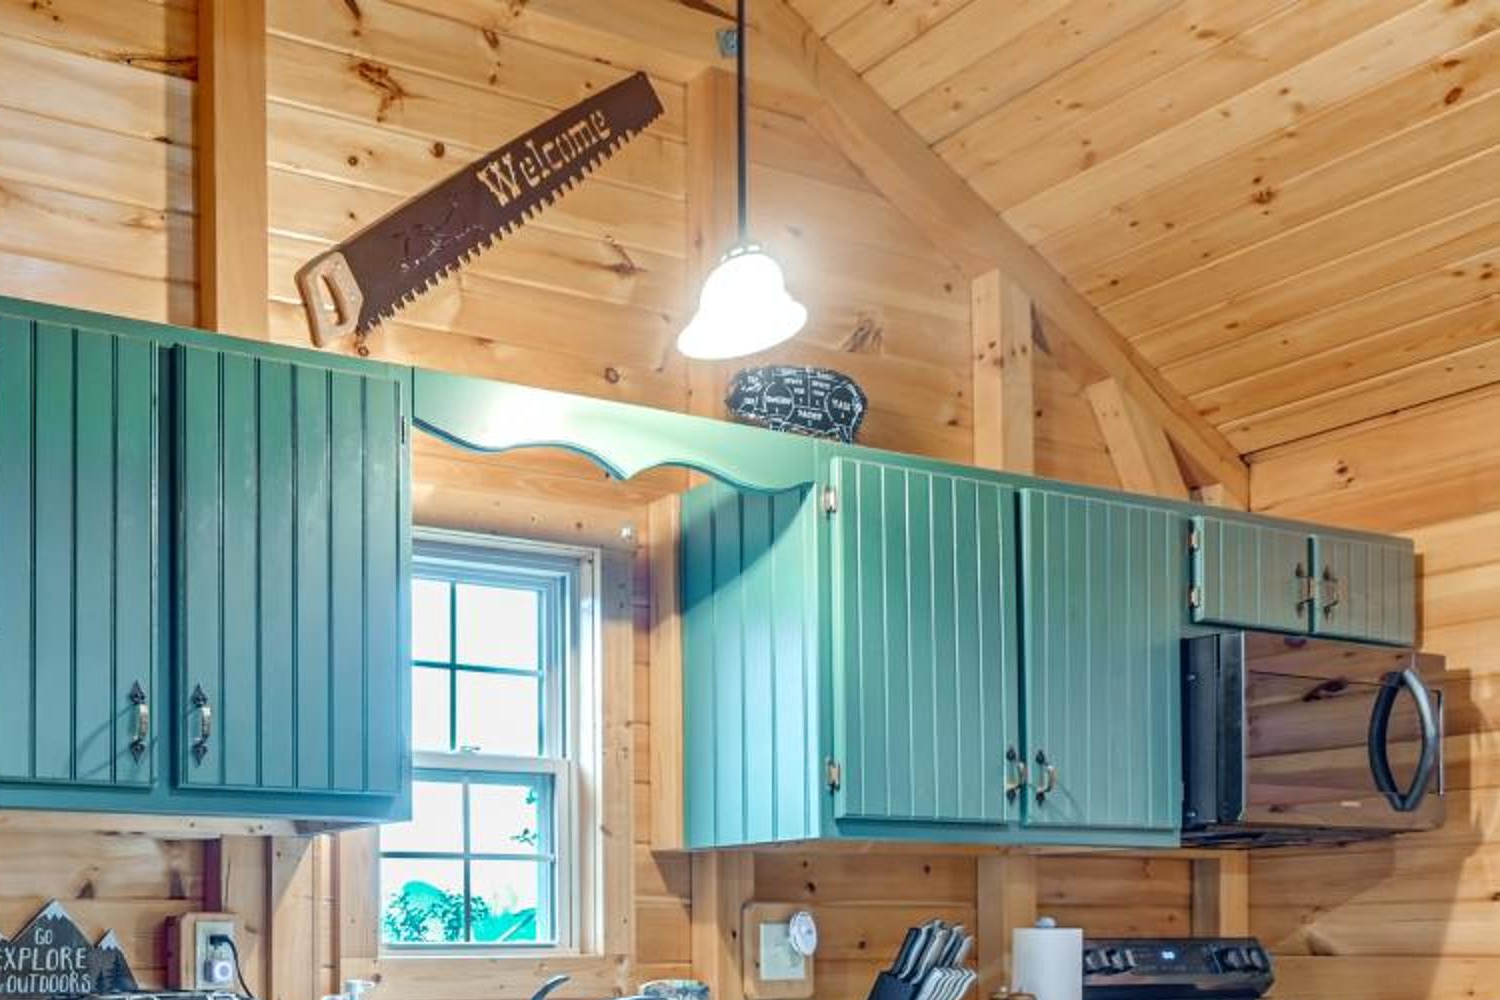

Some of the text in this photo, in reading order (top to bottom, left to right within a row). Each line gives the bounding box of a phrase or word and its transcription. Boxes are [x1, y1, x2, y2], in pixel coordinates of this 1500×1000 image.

[476, 108, 613, 208] Welcome
[34, 927, 53, 945] GO
[6, 972, 91, 993] OUTDOORS
